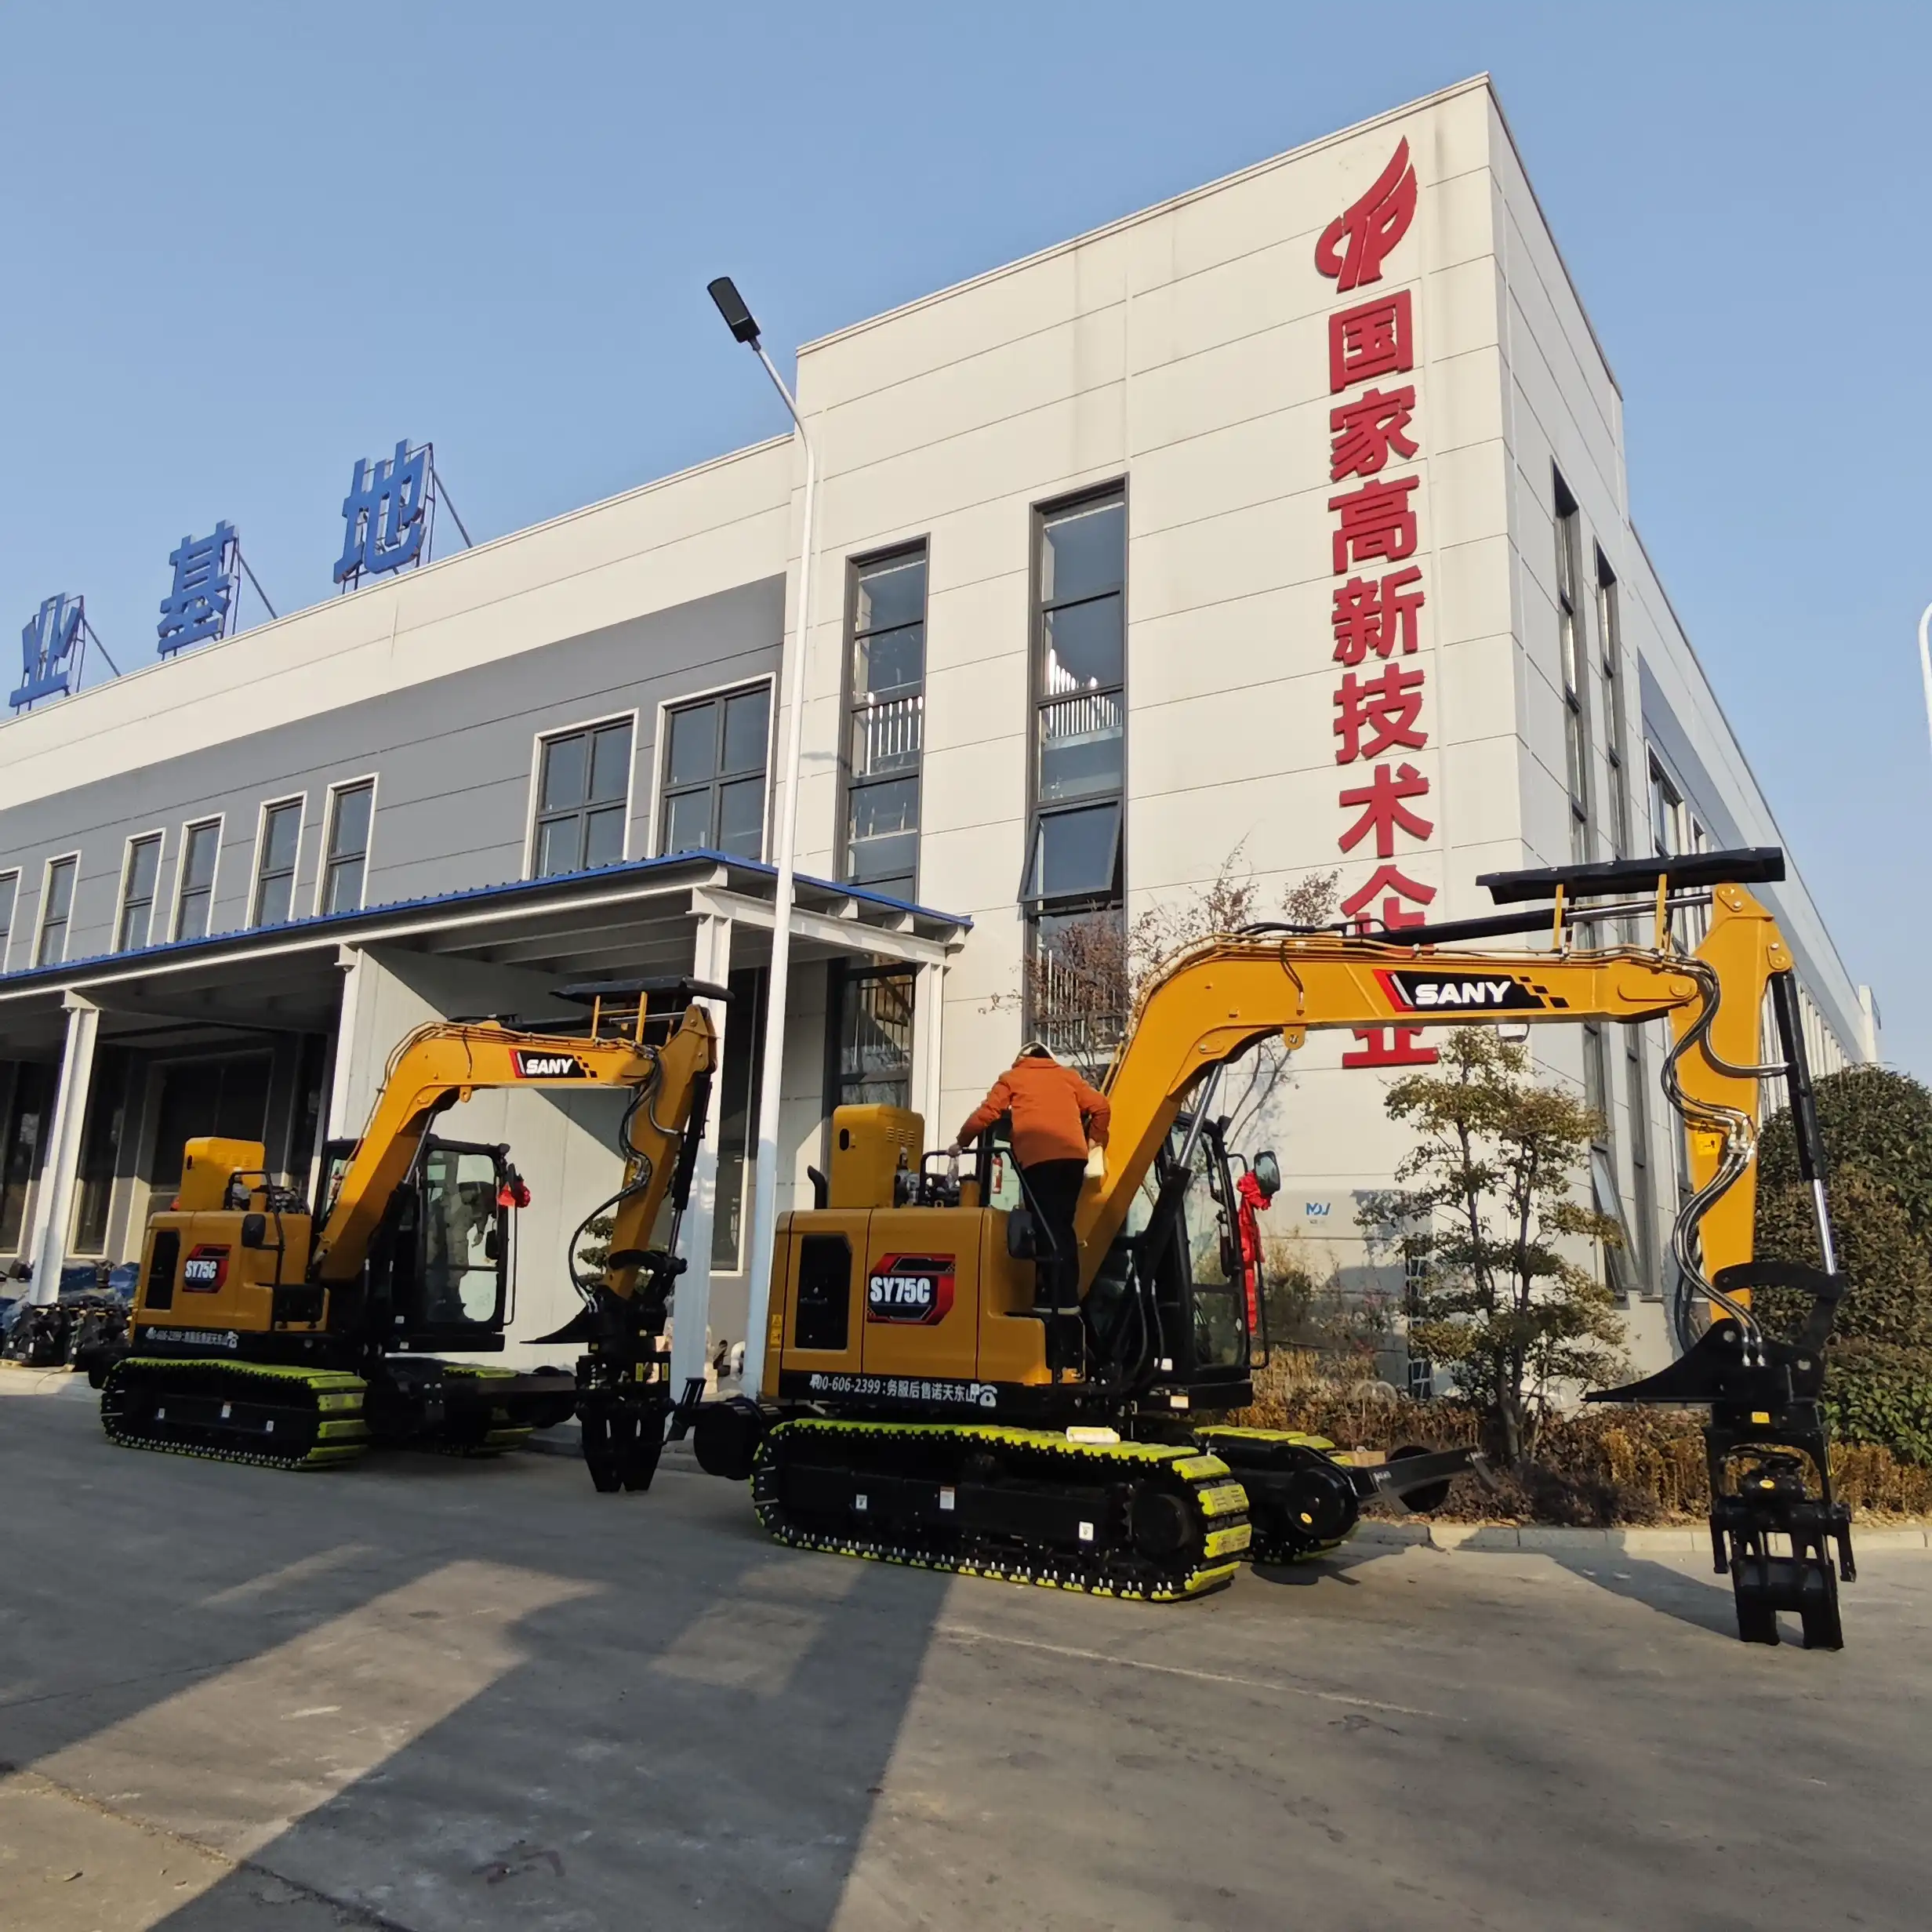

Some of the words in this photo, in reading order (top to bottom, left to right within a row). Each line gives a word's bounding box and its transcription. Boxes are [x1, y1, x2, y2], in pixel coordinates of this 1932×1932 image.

[1415, 981, 1511, 1005] SANY
[526, 1059, 573, 1073] SANY
[185, 1260, 217, 1279] SY75C
[870, 1276, 931, 1303] SY75C
